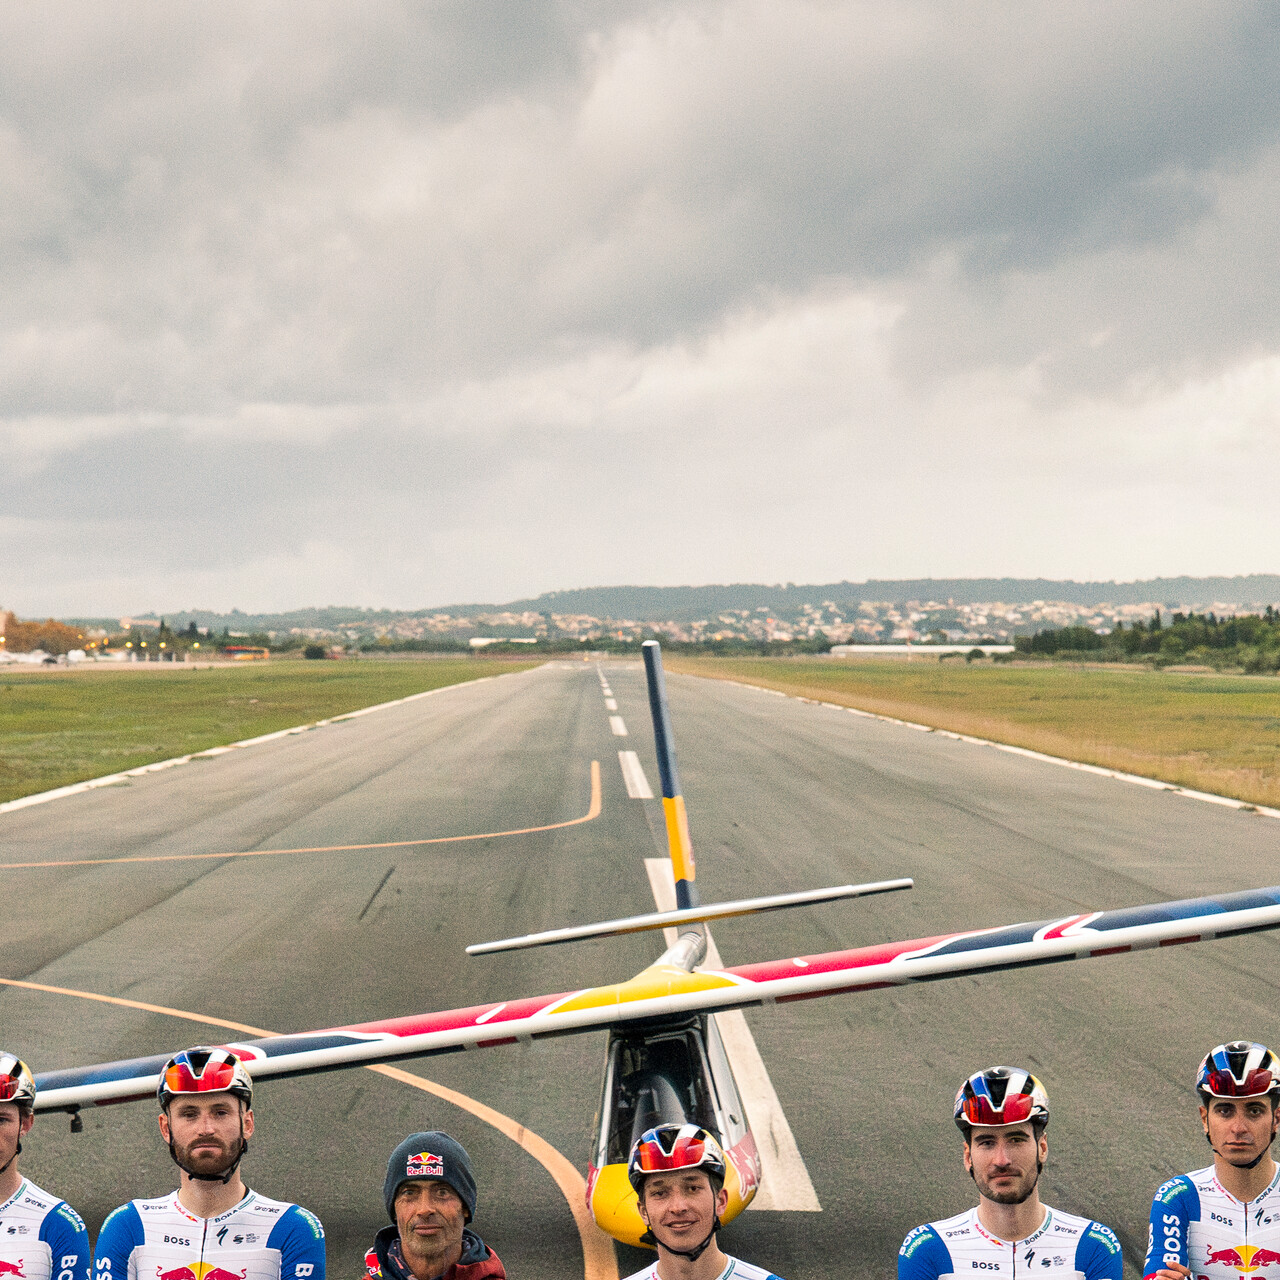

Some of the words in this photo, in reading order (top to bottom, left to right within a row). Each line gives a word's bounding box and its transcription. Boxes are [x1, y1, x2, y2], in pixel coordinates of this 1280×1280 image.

[406, 1165, 424, 1176] Red
[425, 1164, 444, 1176] Bull
[1154, 1178, 1185, 1202] BORA
[61, 1203, 86, 1232] BORA
[1211, 1212, 1233, 1227] BOSS
[163, 1235, 191, 1247] BOSS
[898, 1224, 930, 1256] BORA
[1024, 1230, 1044, 1246] BORA
[1091, 1222, 1122, 1252] BORA
[1162, 1213, 1181, 1264] BOSS
[972, 1261, 1000, 1271] BOSS
